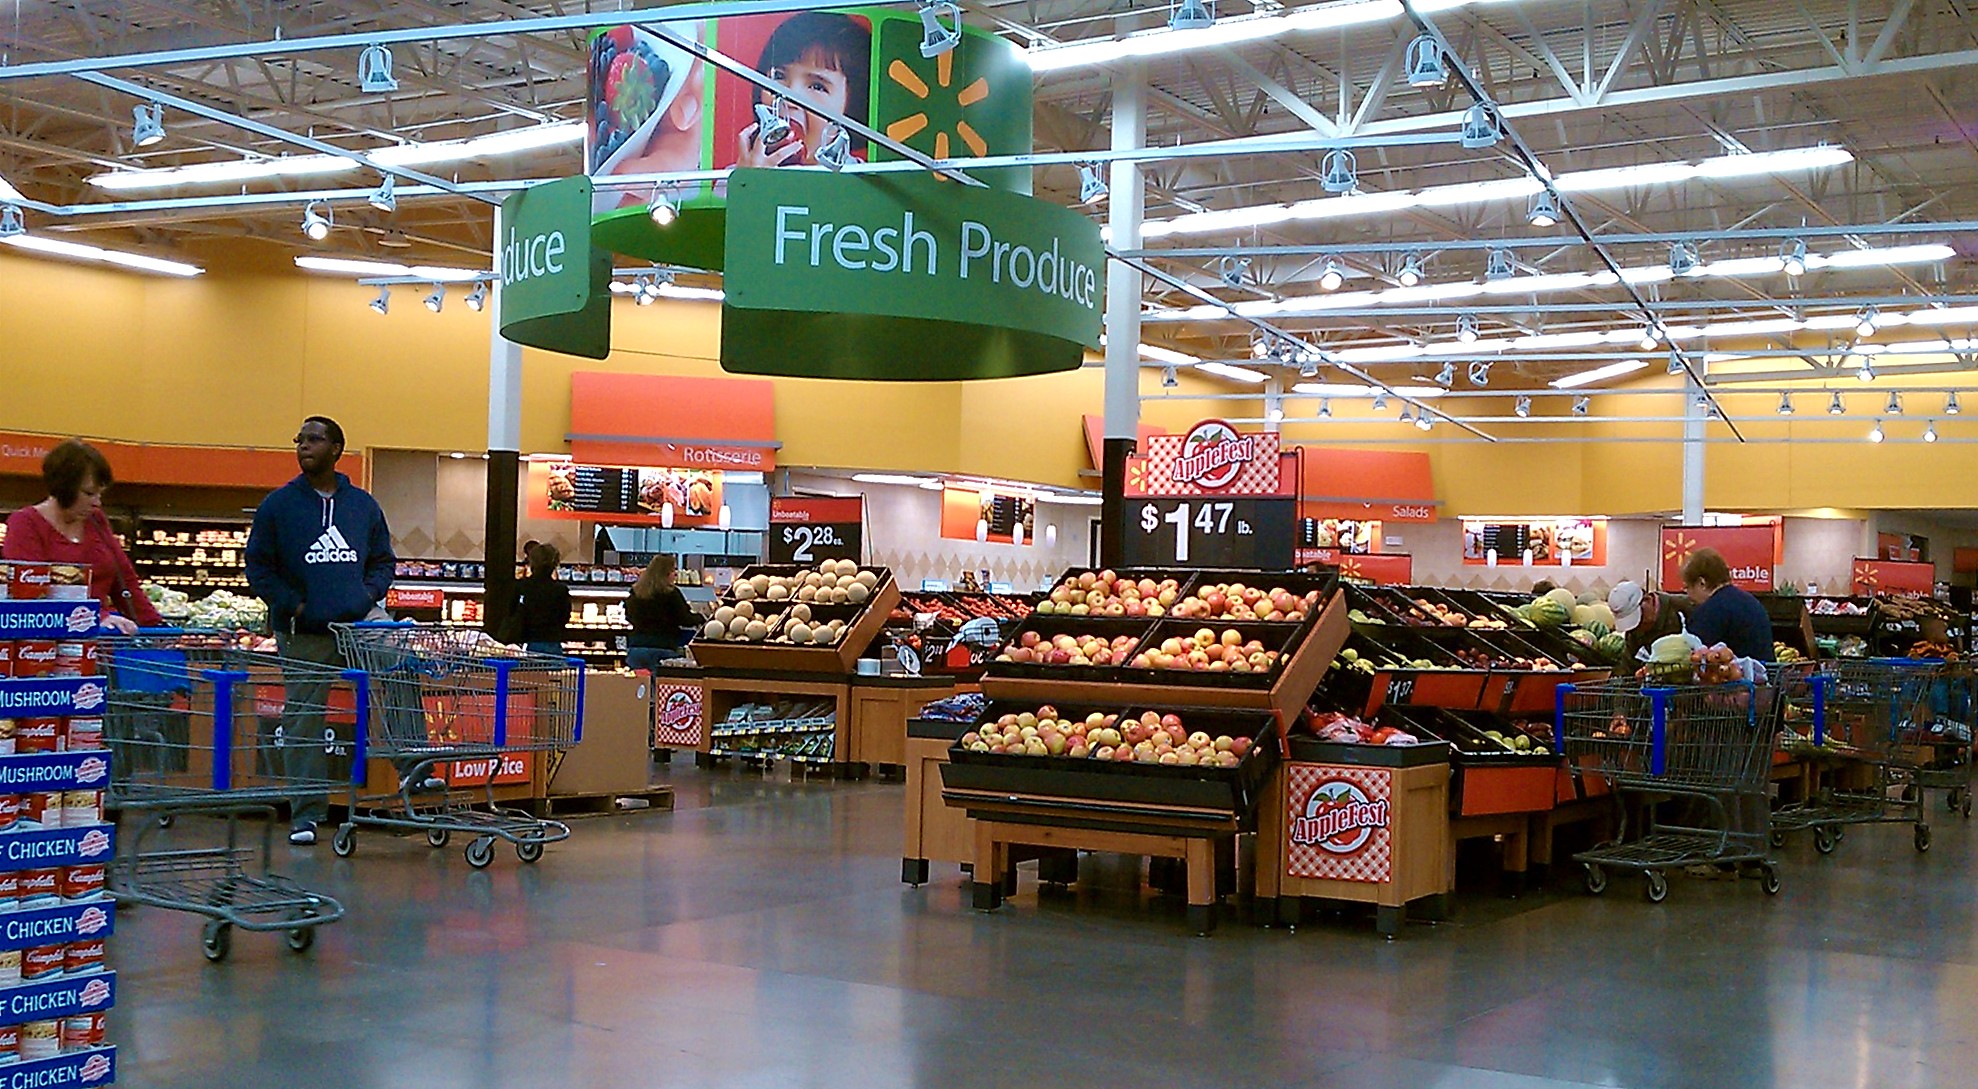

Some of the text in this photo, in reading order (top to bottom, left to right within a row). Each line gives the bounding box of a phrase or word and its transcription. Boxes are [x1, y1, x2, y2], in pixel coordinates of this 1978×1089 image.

[501, 226, 566, 287] duce
[774, 205, 1096, 310] Fresh Produce
[684, 447, 762, 465] Rotisserie
[1173, 437, 1253, 482] AppleFest
[1393, 505, 1429, 519] Salads
[305, 548, 358, 564] adidas
[1730, 566, 1769, 579] table
[0, 613, 64, 629] USHROOM
[455, 761, 487, 778] Low
[1293, 800, 1387, 844] AppleFest
[8, 839, 76, 861] CHICKEN
[6, 917, 74, 941] CHICKEN
[11, 989, 77, 1015] CHICKEN
[12, 1065, 77, 1089] CHICKEN
